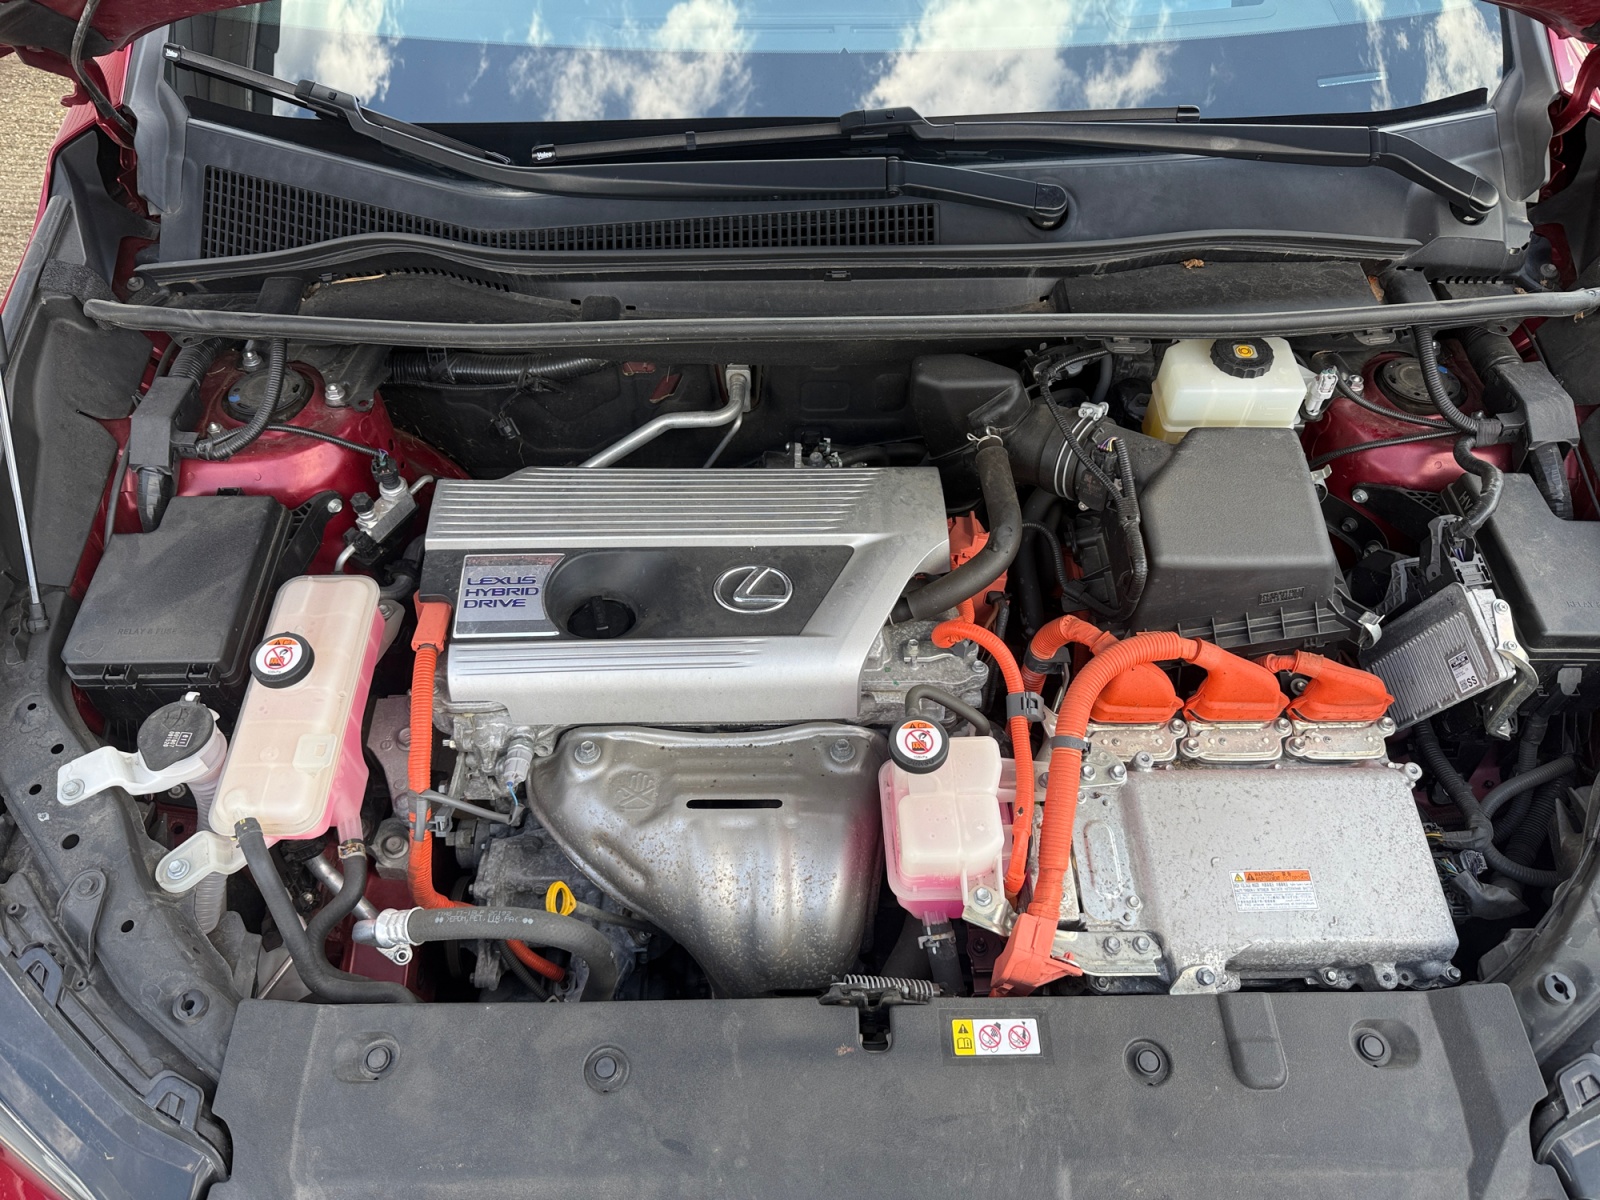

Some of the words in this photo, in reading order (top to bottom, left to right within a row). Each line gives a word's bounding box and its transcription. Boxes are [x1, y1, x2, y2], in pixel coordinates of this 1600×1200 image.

[1458, 490, 1474, 511] HV
[467, 576, 536, 585] LEXUS
[465, 587, 539, 596] HYBRID
[463, 598, 526, 608] DRIVE
[1466, 675, 1478, 687] SS
